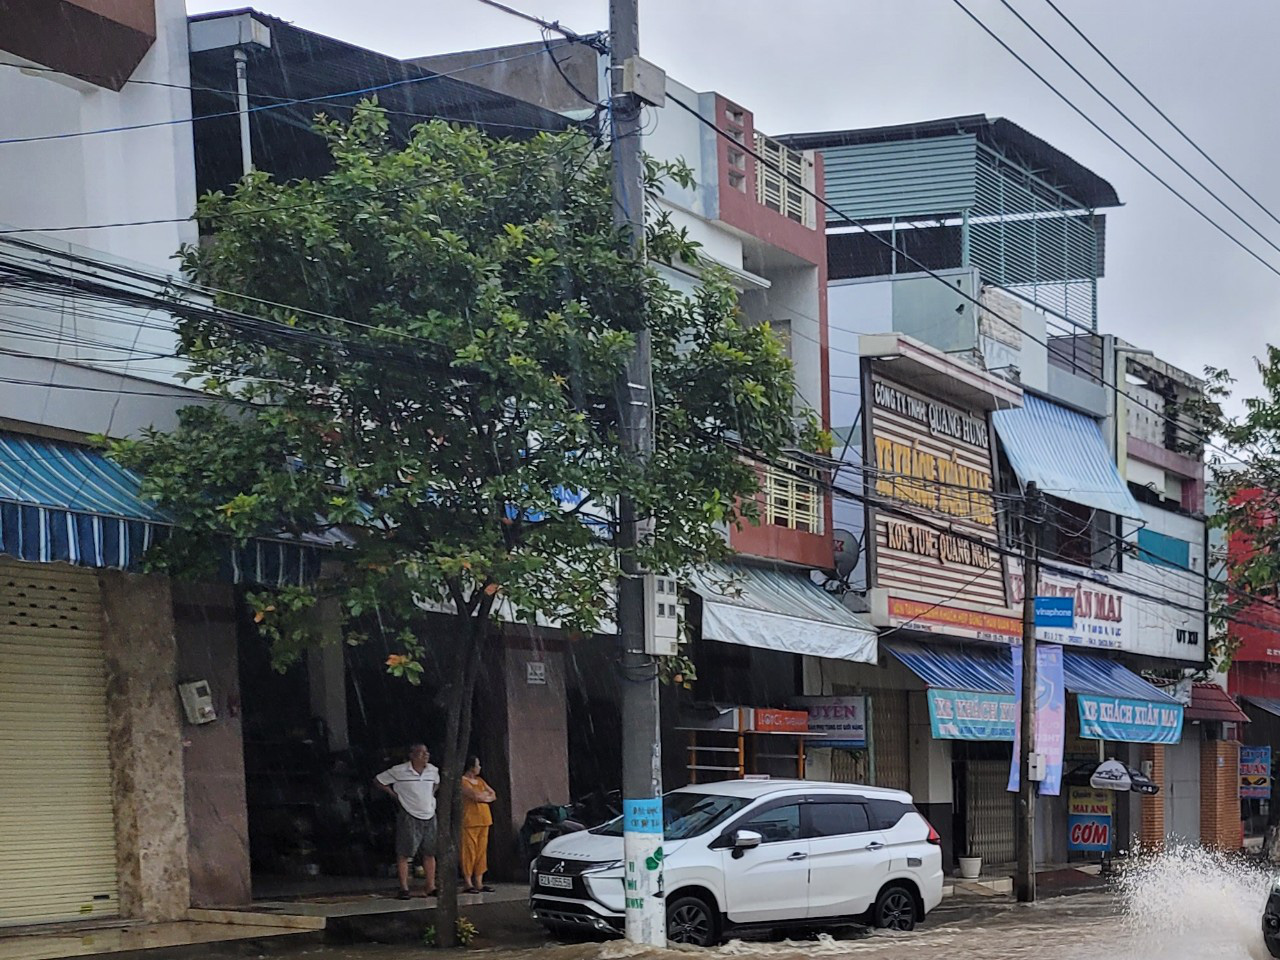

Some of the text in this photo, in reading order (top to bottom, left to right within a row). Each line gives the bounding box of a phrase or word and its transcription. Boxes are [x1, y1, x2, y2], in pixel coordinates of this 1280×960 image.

[928, 403, 961, 436] QUANG
[1035, 607, 1072, 618] vinaphone
[1093, 592, 1123, 623] MAI
[1083, 700, 1098, 721] XE
[1100, 699, 1133, 724] KHÁCH
[1134, 703, 1160, 727] XUÂN
[1071, 820, 1110, 846] CƠM
